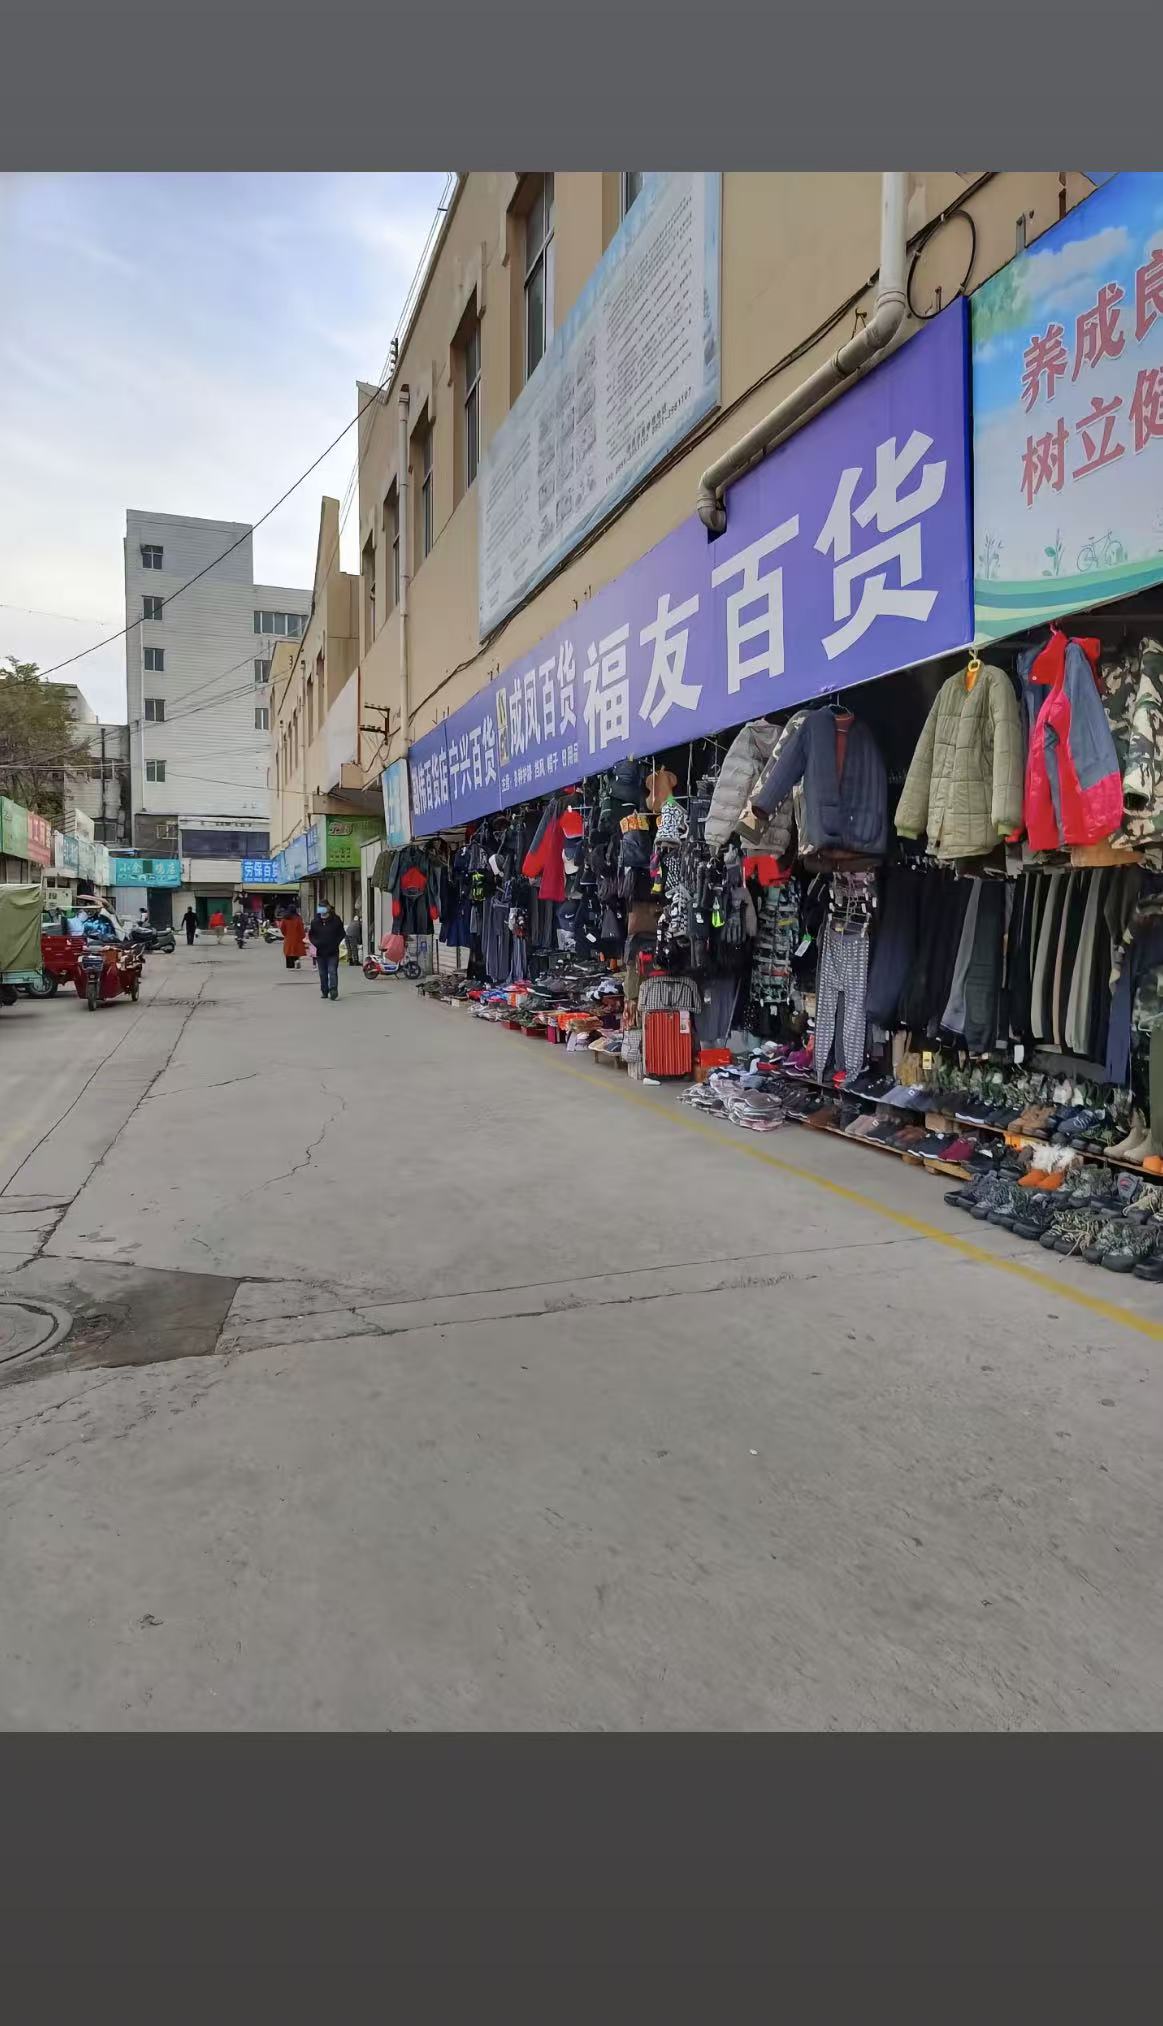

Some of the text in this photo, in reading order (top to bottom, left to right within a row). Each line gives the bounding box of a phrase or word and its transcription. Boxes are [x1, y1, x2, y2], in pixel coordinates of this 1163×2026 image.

[584, 430, 947, 754] 福友百货
[509, 640, 576, 756] 成凤百货
[450, 715, 497, 799] 宁兴百货
